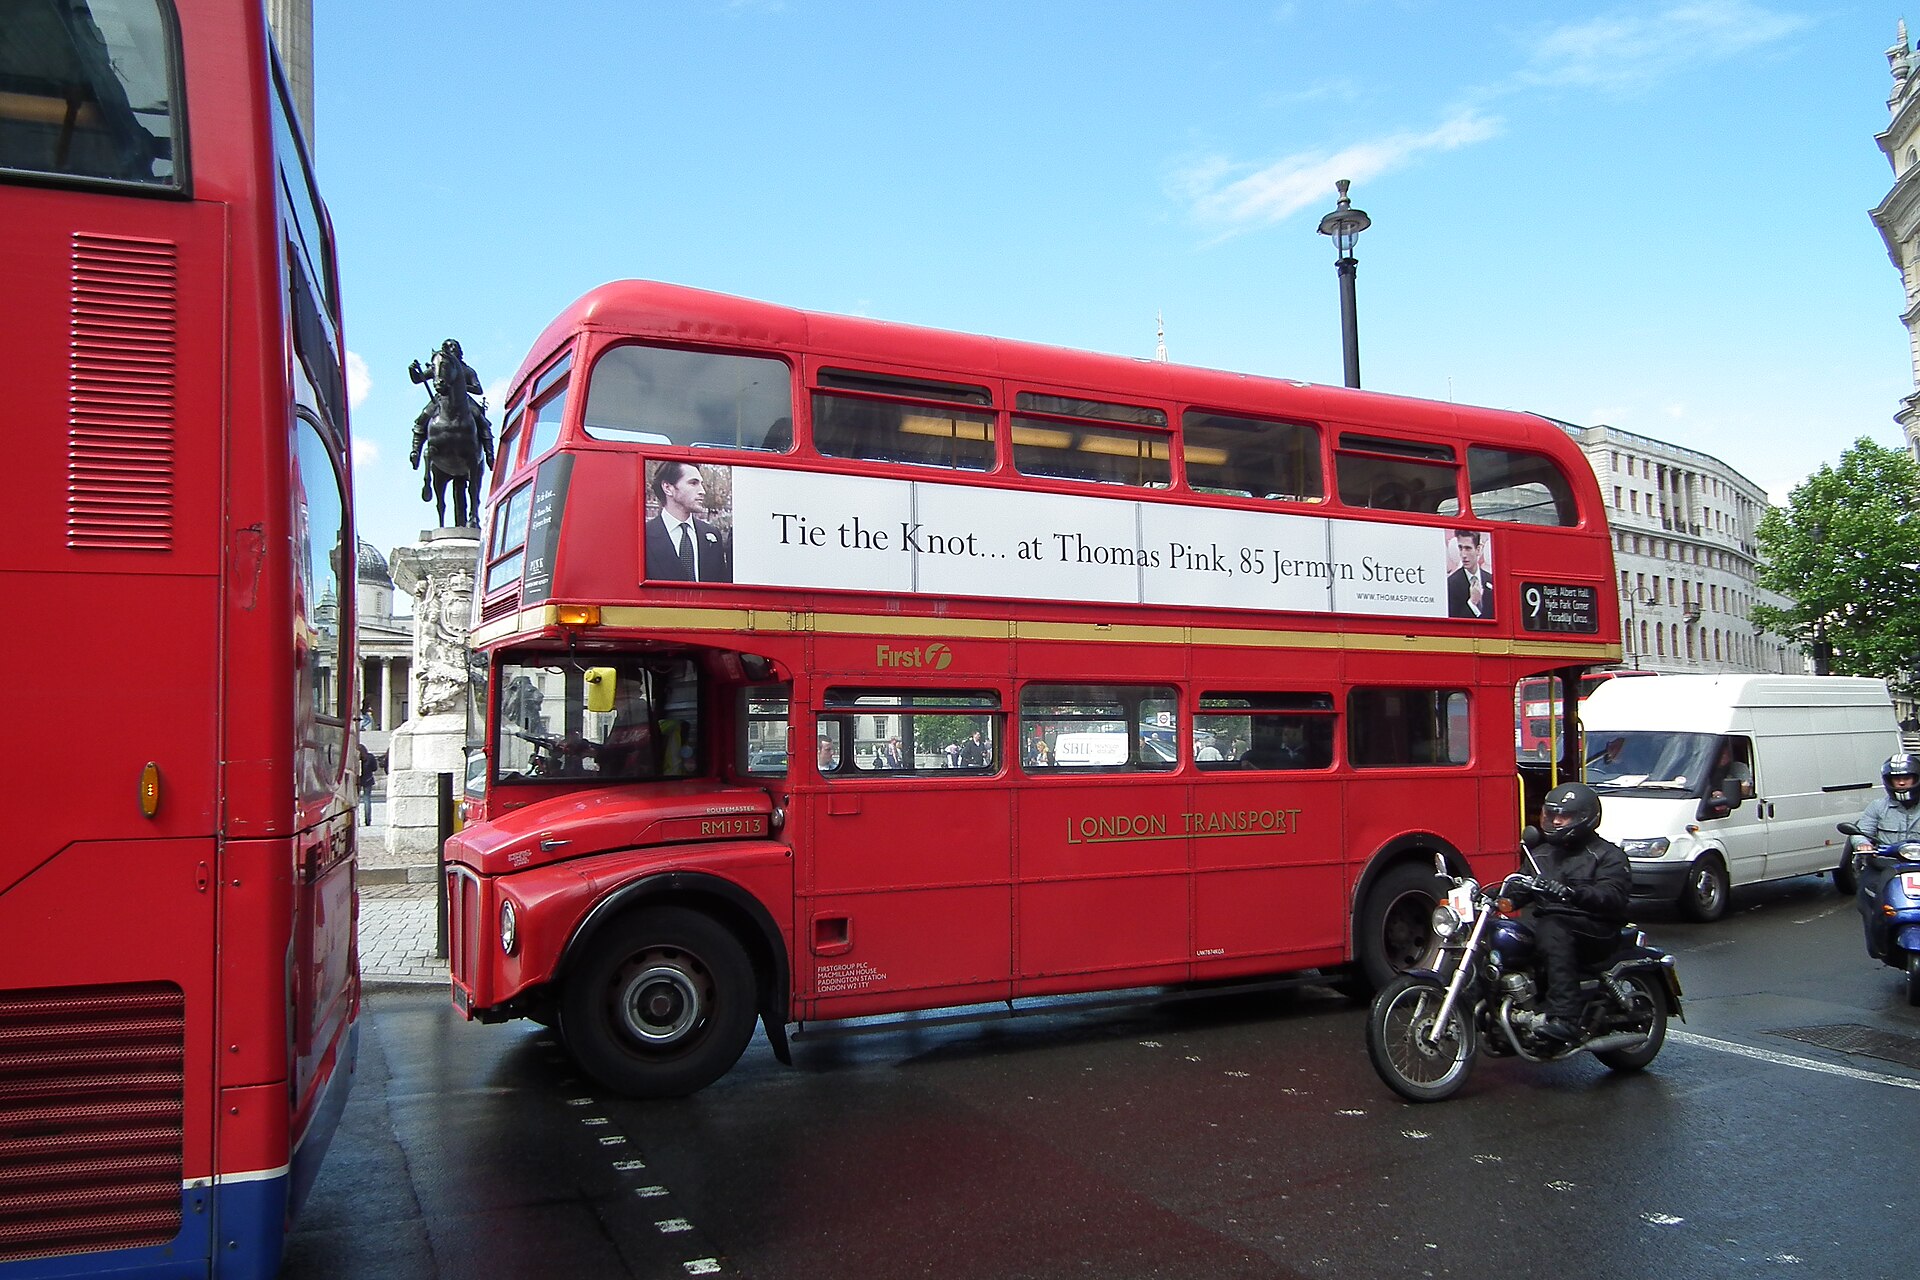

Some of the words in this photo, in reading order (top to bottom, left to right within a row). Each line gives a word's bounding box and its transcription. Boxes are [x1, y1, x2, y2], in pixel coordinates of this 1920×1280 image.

[772, 512, 826, 547] Tie
[837, 516, 889, 550] the
[900, 522, 1005, 559] Knot...
[1018, 536, 1043, 560] at
[1053, 533, 1160, 569] Thomas
[1168, 542, 1233, 577] Pink,
[1240, 547, 1265, 575] 85
[1271, 550, 1355, 590] Jermyn
[1362, 556, 1426, 585] Street
[1356, 592, 1435, 604] WWW.THOMASPINK.COM
[1543, 586, 1558, 598] Royal
[1560, 586, 1577, 597] Albert
[1578, 588, 1589, 597] Hall
[1526, 588, 1540, 617] 9
[1544, 598, 1558, 611] Hyde
[1560, 599, 1571, 610] Park
[1573, 600, 1589, 610] Corner
[1548, 612, 1571, 625] Piccadilly
[1573, 613, 1587, 623] Circus
[876, 644, 922, 668] First
[701, 819, 761, 835] RM1913
[1067, 814, 1167, 844] LONDON
[1181, 808, 1302, 834] TRANSPORT
[817, 975, 860, 986] PADDINGTON
[860, 973, 887, 982] STATION
[818, 970, 854, 979] MACMILLAN
[817, 984, 846, 993] LONDON
[847, 982, 857, 990] W2
